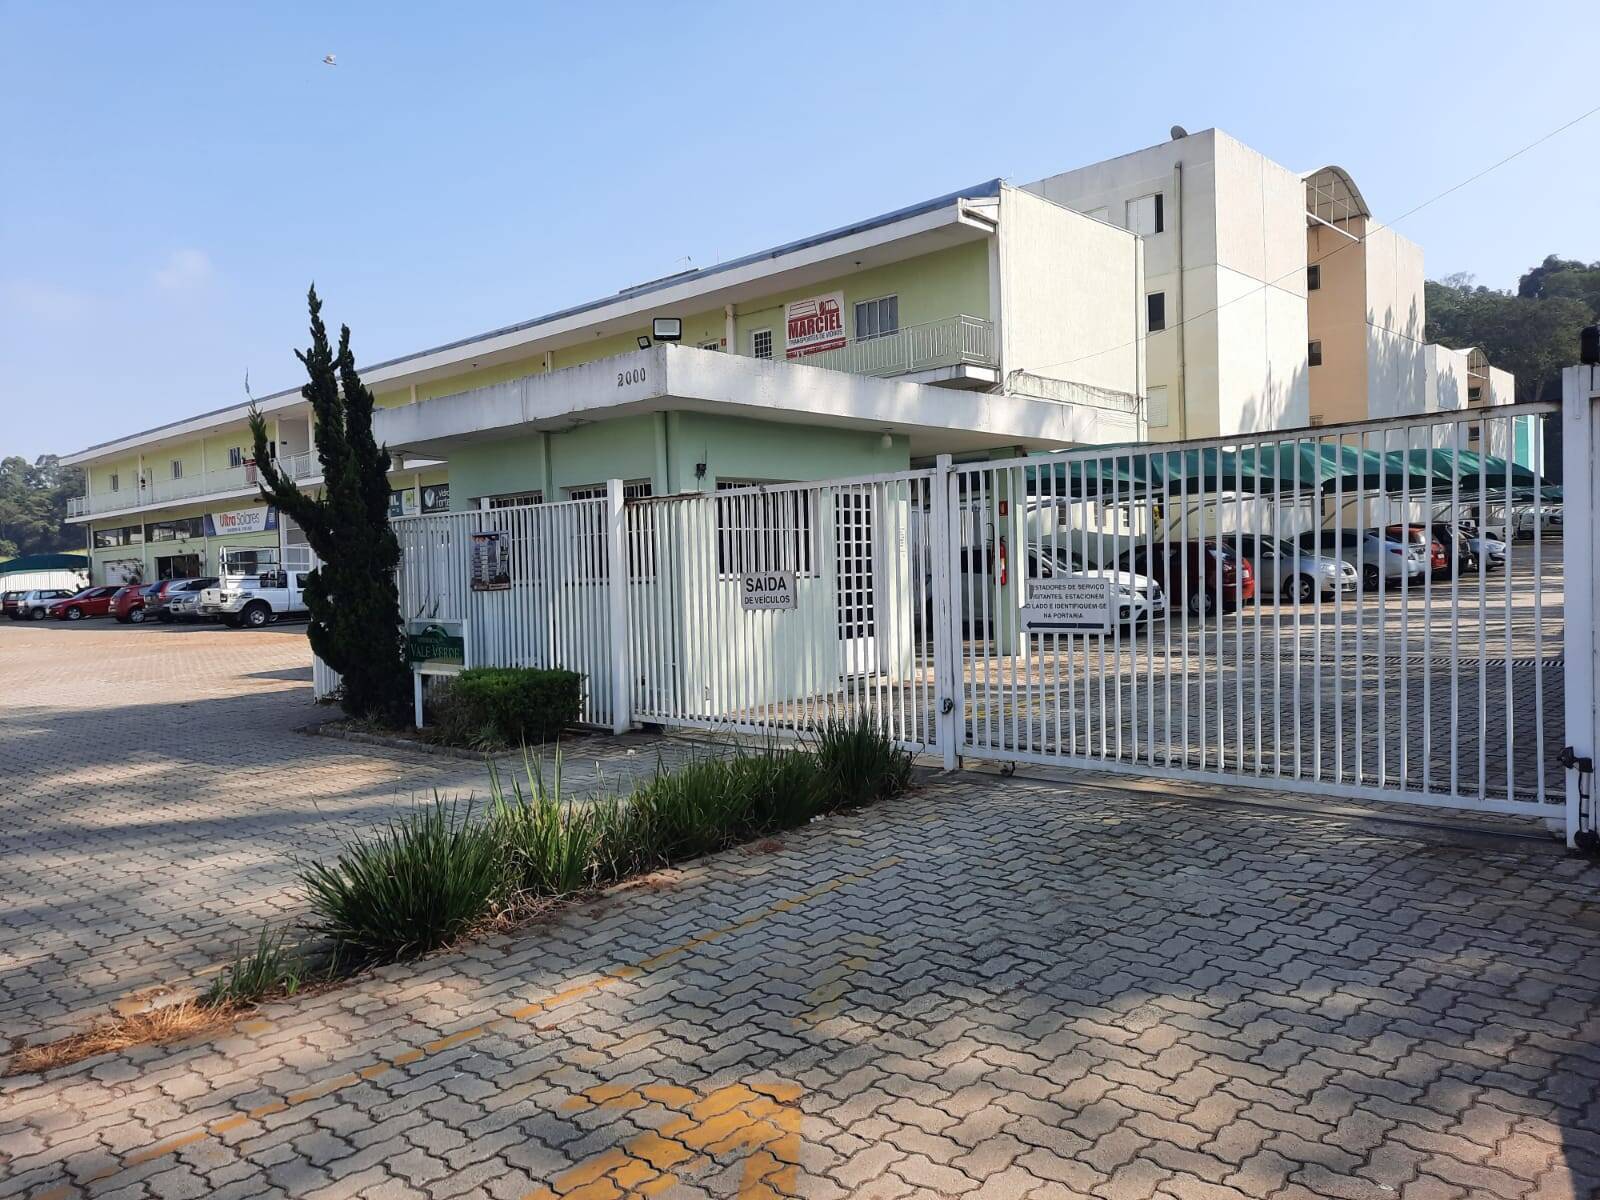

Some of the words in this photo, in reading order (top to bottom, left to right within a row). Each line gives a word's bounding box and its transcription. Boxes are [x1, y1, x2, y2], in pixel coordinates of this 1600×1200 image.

[788, 312, 843, 340] MARCIEL
[617, 367, 646, 387] 2000
[745, 573, 787, 593] SAÍDA
[1078, 583, 1105, 591] SERVIÇO
[744, 596, 754, 605] DE
[755, 594, 791, 604] VEÍCULOS
